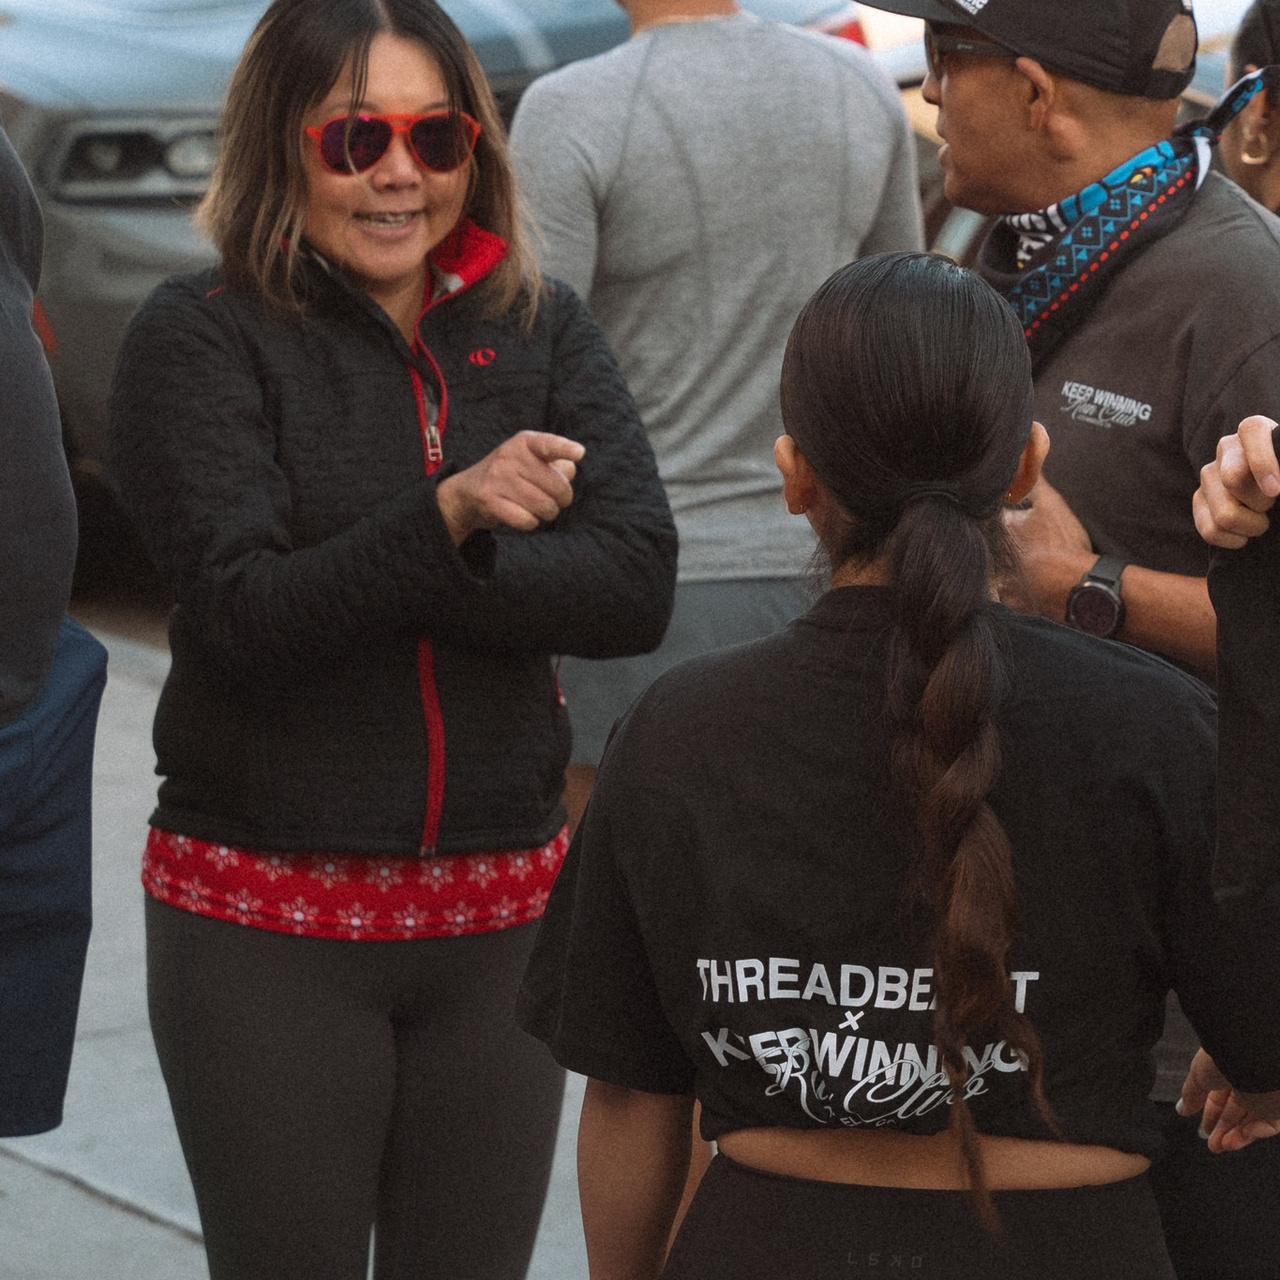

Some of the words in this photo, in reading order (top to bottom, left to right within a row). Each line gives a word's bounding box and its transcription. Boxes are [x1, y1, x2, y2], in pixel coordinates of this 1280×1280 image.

[1061, 381, 1095, 401] KEEP
[1093, 389, 1152, 421] WINNING
[697, 957, 1040, 1014] THREADBET
